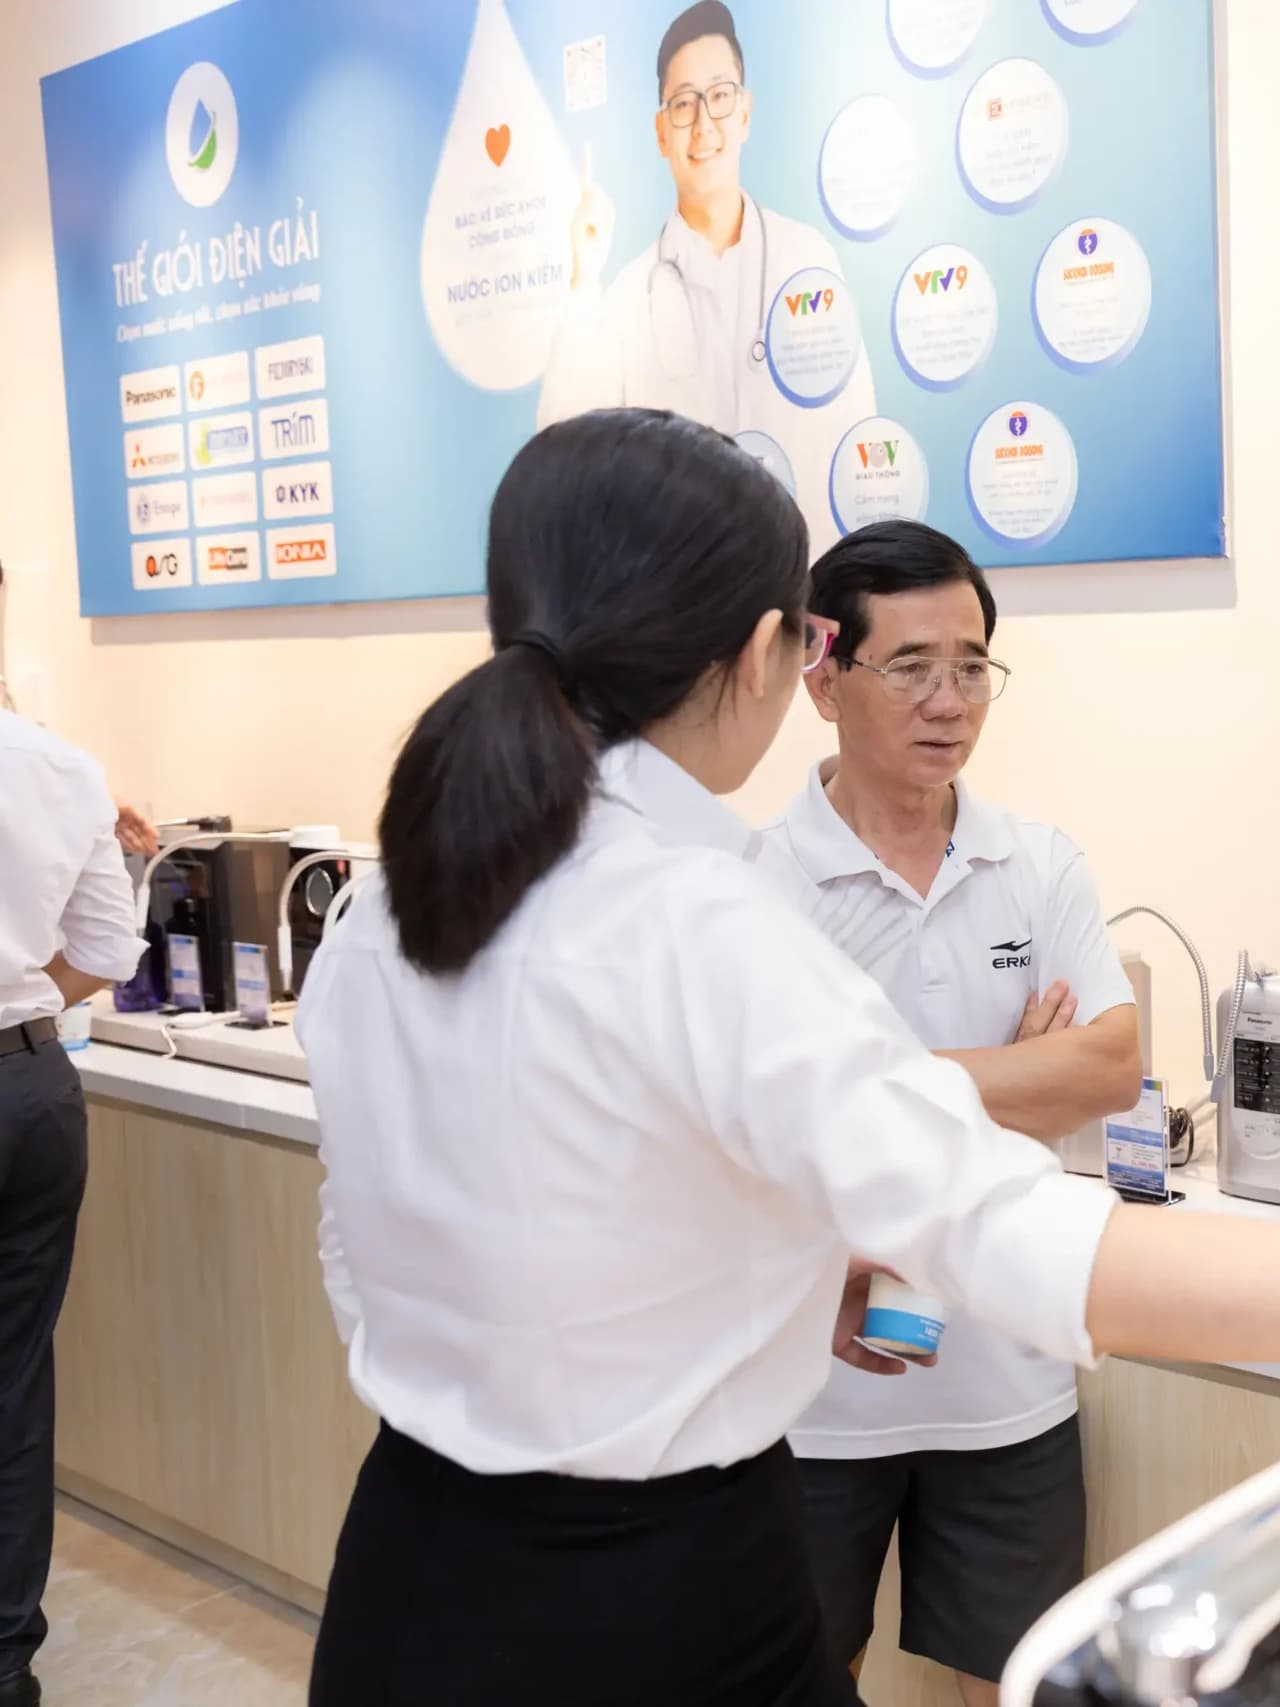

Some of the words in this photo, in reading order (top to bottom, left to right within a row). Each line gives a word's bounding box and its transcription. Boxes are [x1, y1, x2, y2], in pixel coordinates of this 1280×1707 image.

[112, 239, 149, 307] THẾ
[209, 221, 262, 288] ĐIỆN
[268, 196, 319, 267] GIẢI
[495, 271, 522, 294] ION
[126, 386, 176, 405] Panasonic
[290, 482, 319, 504] KYK
